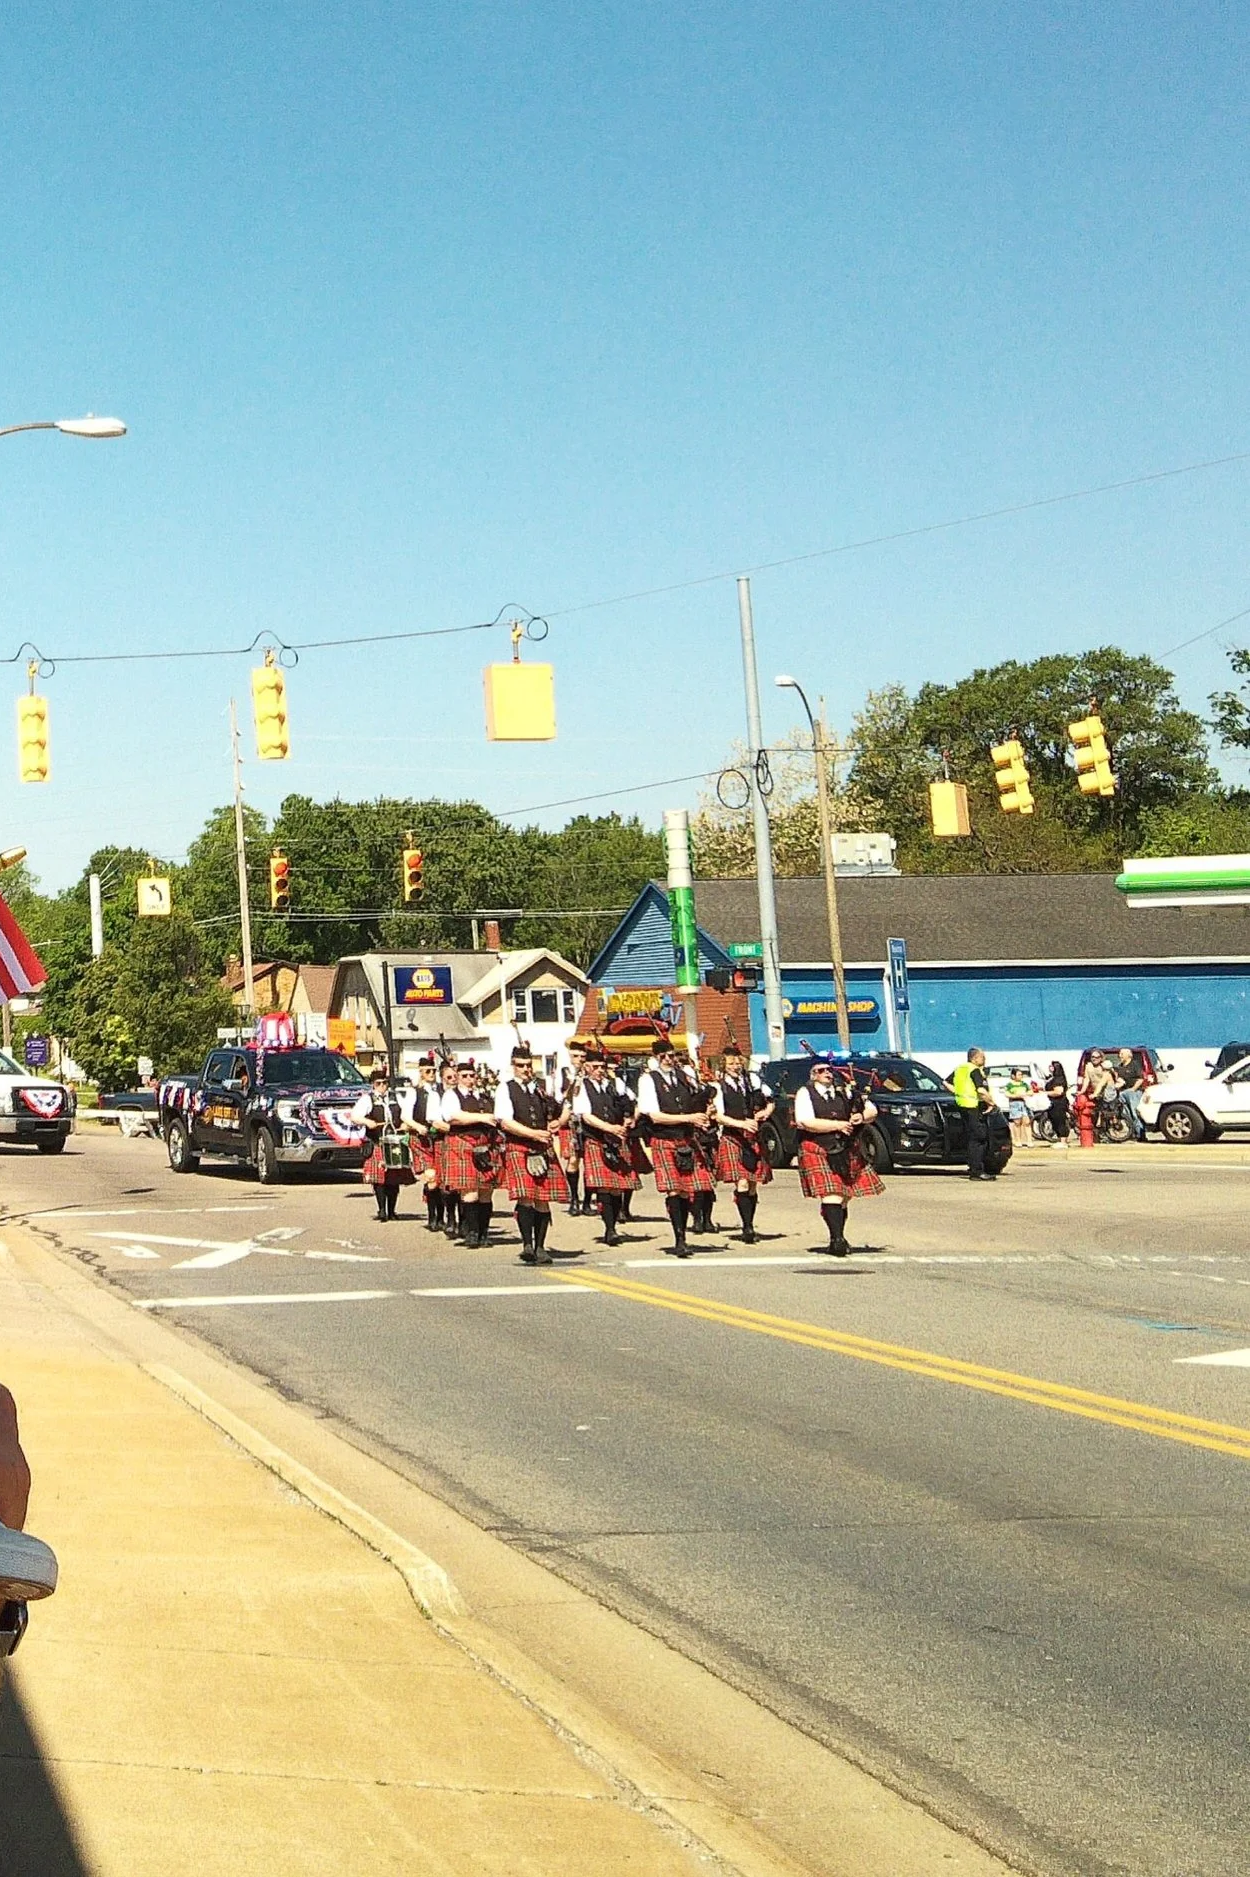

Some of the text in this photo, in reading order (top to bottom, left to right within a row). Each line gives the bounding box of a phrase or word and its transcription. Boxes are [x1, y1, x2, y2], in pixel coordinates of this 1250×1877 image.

[405, 987, 445, 999] AUTO PARTS
[796, 1000, 875, 1013] MACHIN SHOP
